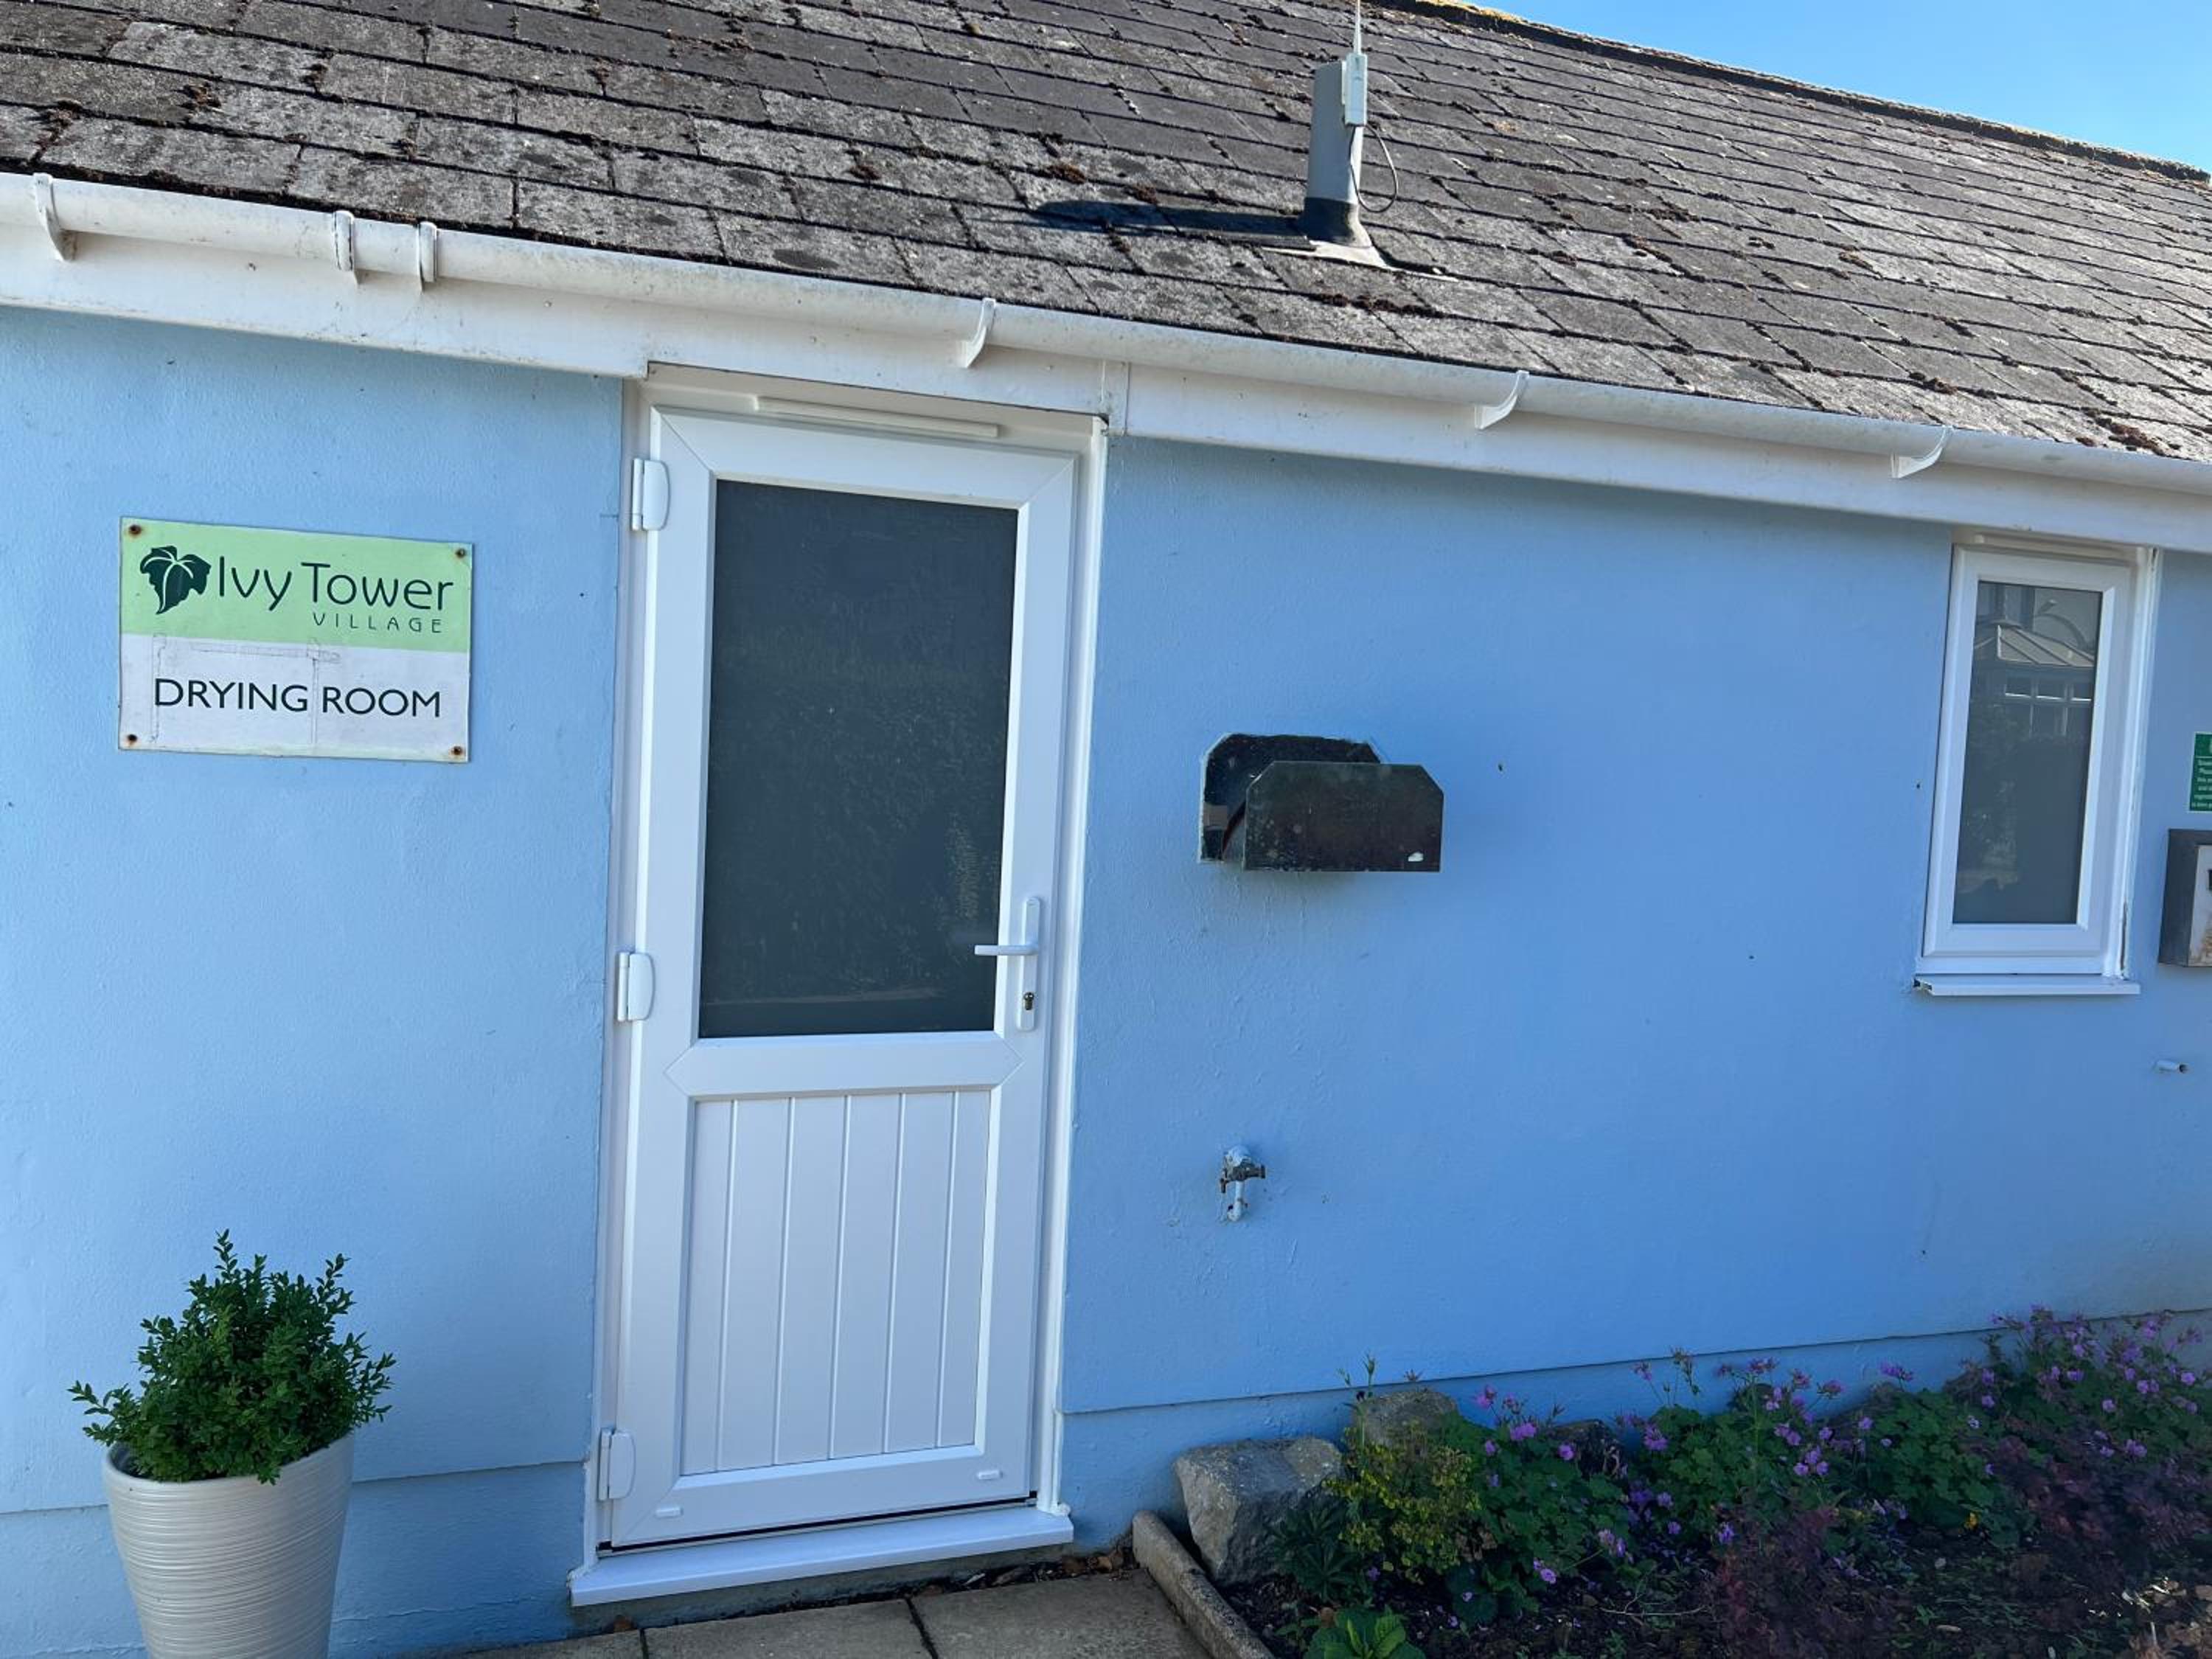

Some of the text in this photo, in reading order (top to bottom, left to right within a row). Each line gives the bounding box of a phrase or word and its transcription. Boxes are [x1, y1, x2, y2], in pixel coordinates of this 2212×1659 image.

[219, 556, 453, 611] Ivy Tower
[313, 613, 442, 633] VILLAGE
[155, 678, 441, 717] DRYING ROOM
